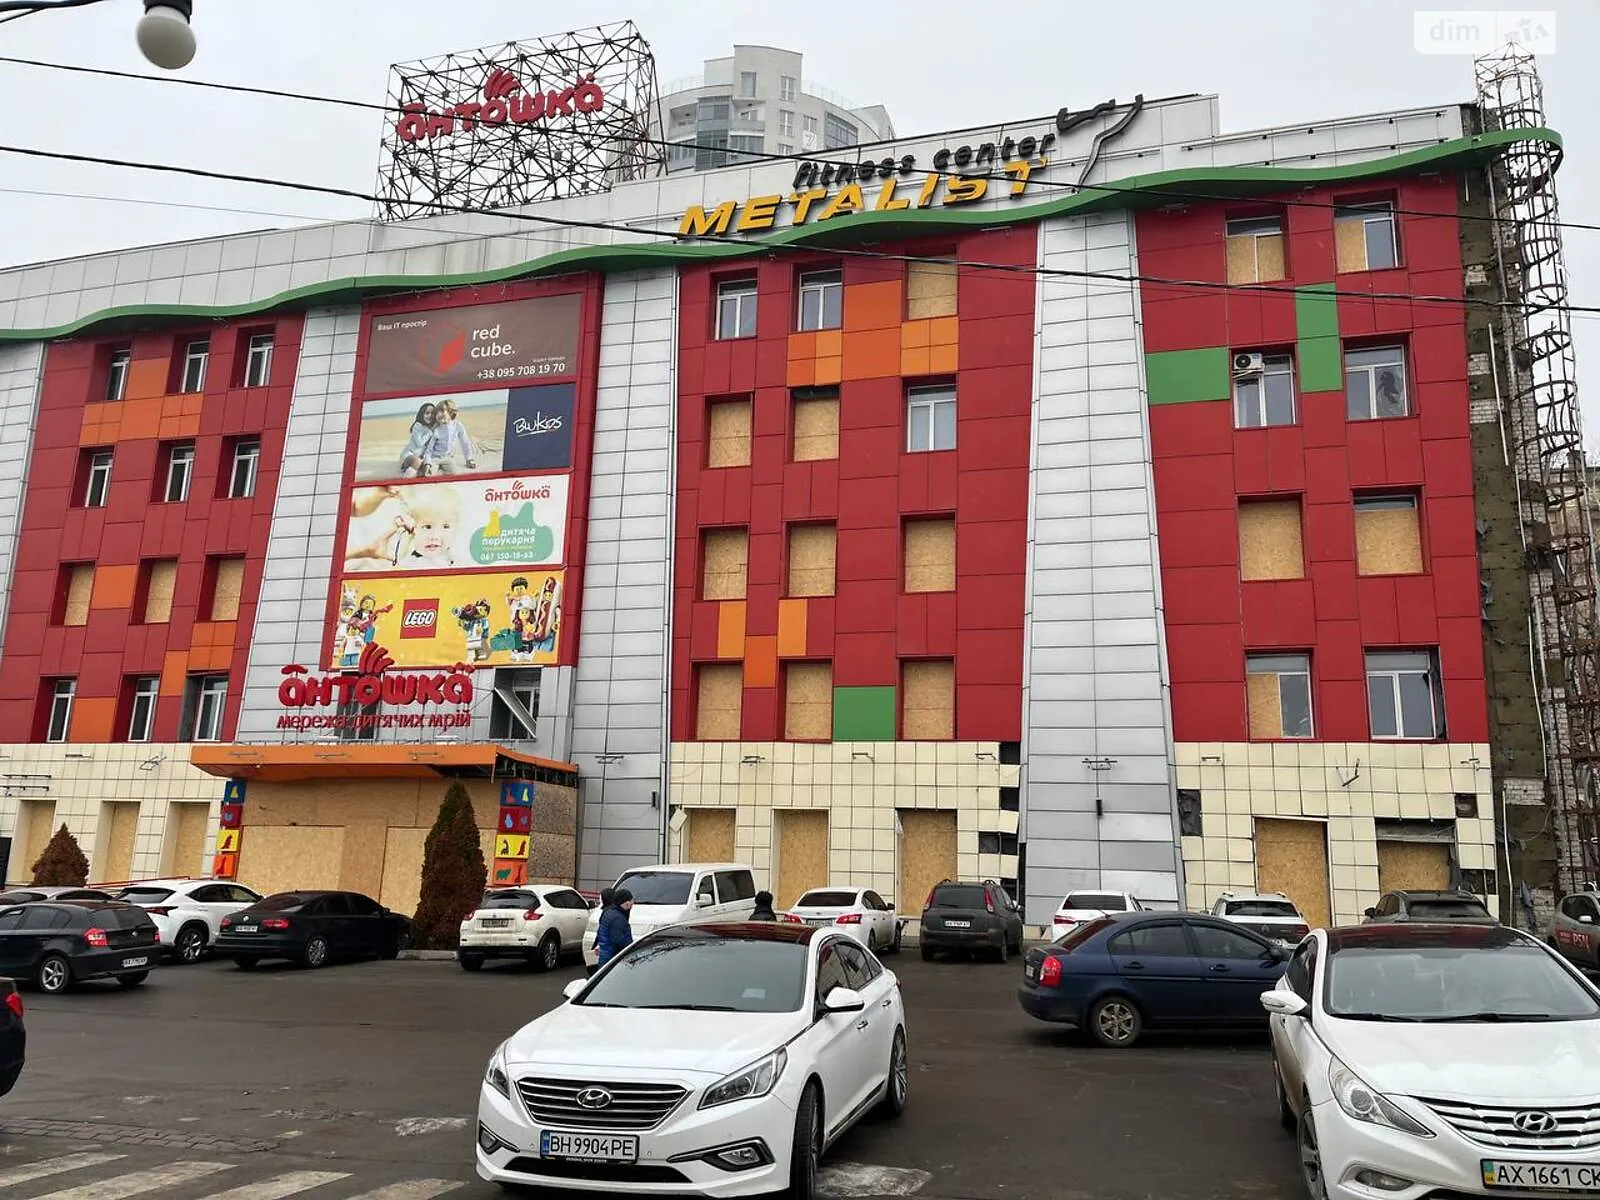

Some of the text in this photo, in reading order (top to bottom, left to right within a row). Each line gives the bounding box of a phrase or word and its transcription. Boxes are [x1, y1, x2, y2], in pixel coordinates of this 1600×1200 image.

[793, 133, 1056, 189] fitness center
[678, 156, 1049, 237] METALIST
[472, 324, 500, 340] red
[470, 342, 516, 358] cube.
[477, 362, 565, 379] +38 095 708 19 70
[404, 610, 435, 626] LEGO
[277, 709, 471, 733] мережа дитячих мрій
[550, 1135, 633, 1156] BH 9904 PE
[1498, 1165, 1524, 1183] AX
[1528, 1166, 1571, 1185] 1661
